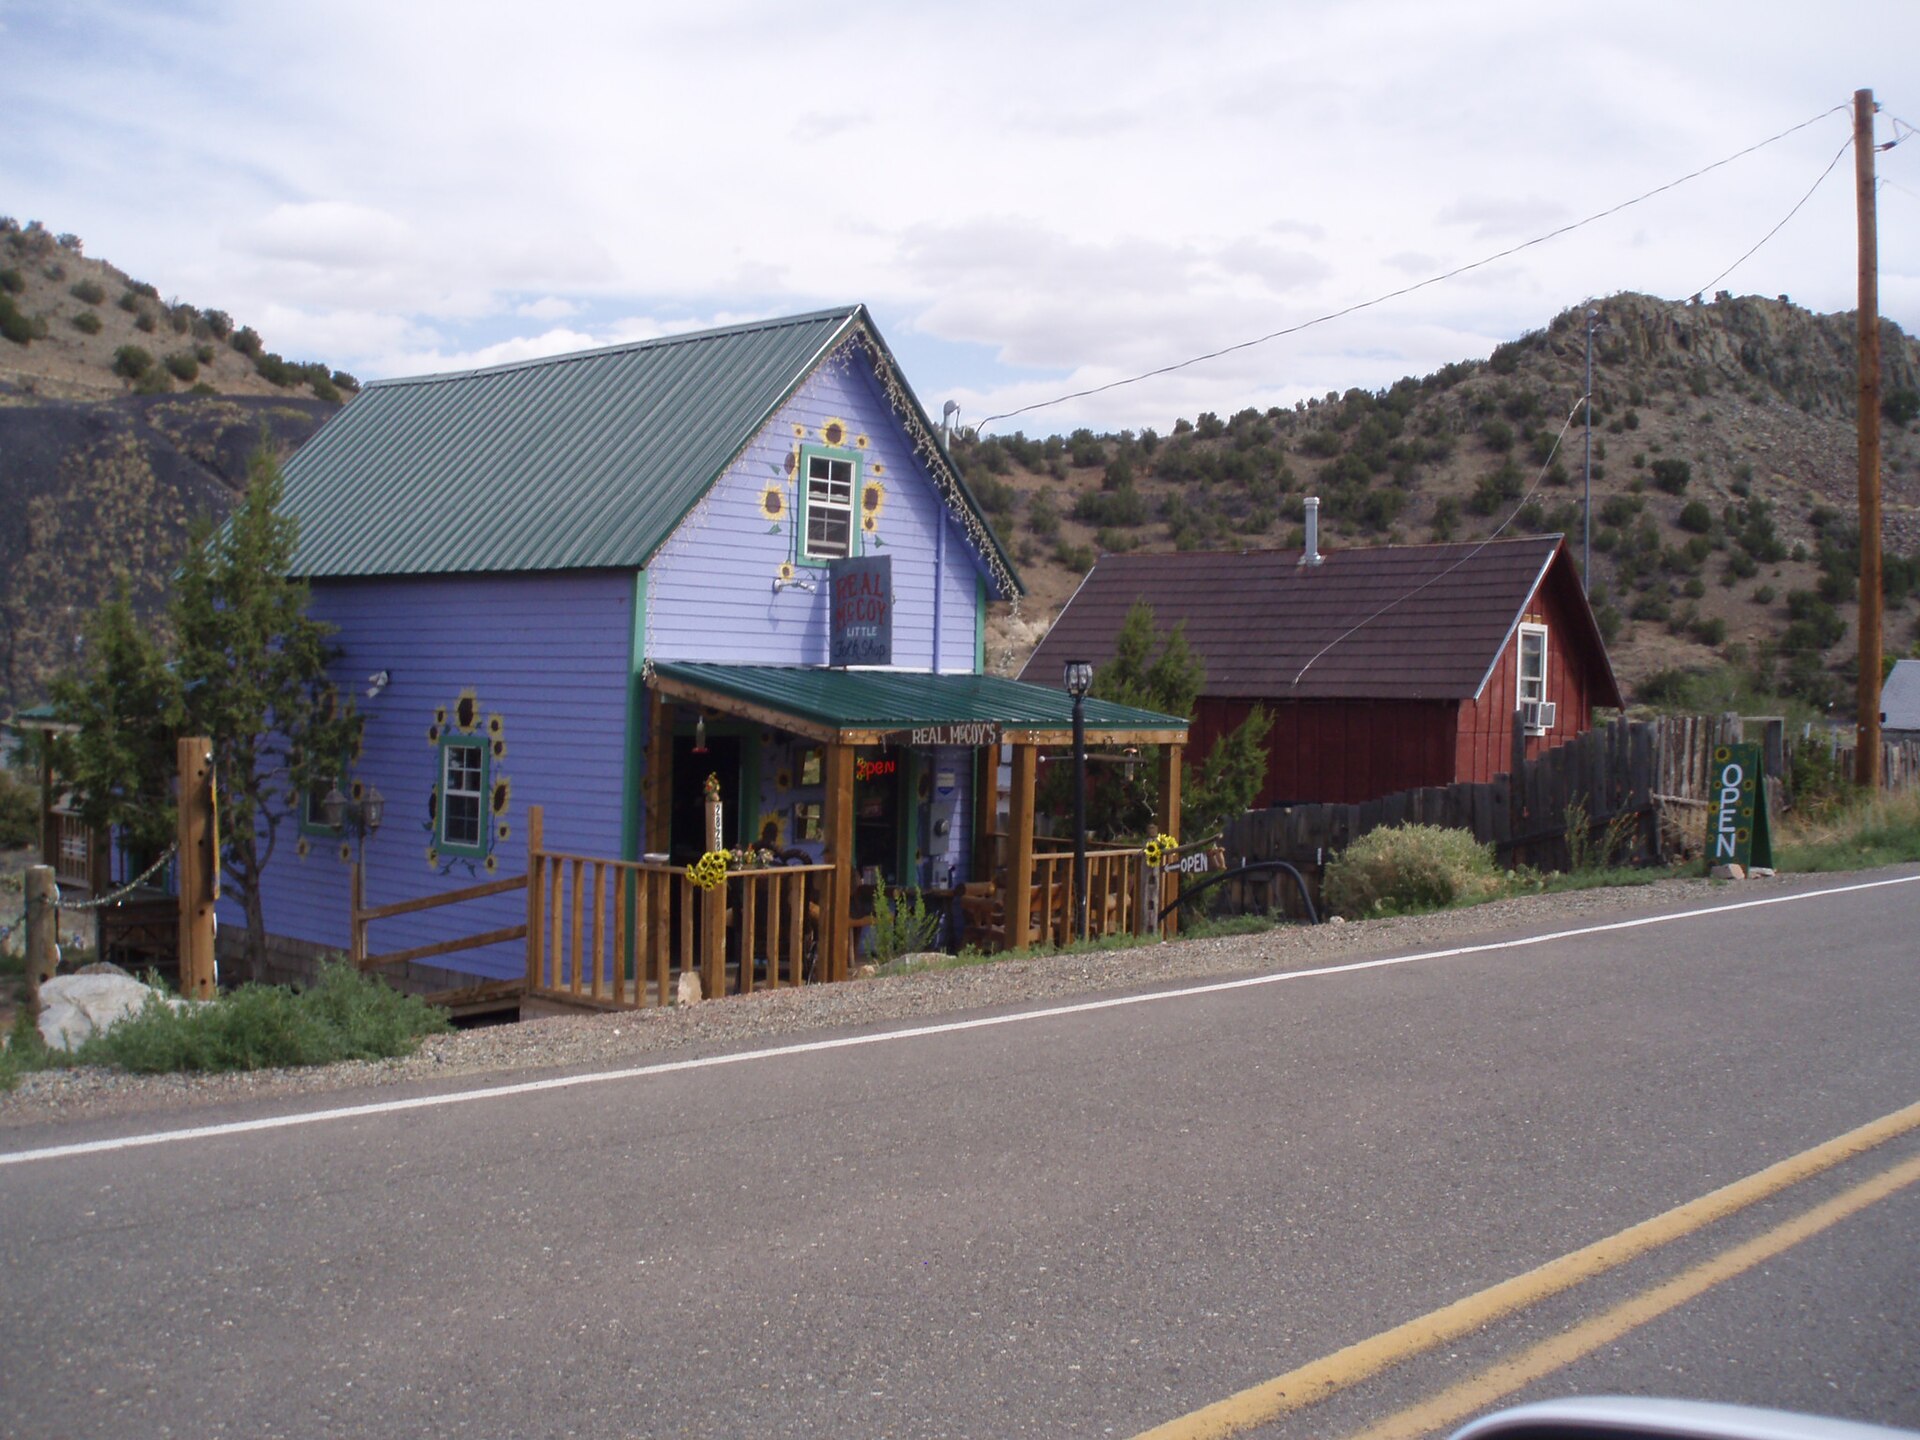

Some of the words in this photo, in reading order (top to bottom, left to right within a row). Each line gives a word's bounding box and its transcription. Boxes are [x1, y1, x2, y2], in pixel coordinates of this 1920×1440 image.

[836, 572, 884, 603] REAL
[846, 626, 878, 638] LITTLE
[912, 726, 946, 744] REAL
[1716, 763, 1743, 858] OPEN
[1180, 852, 1208, 872] OPEN
